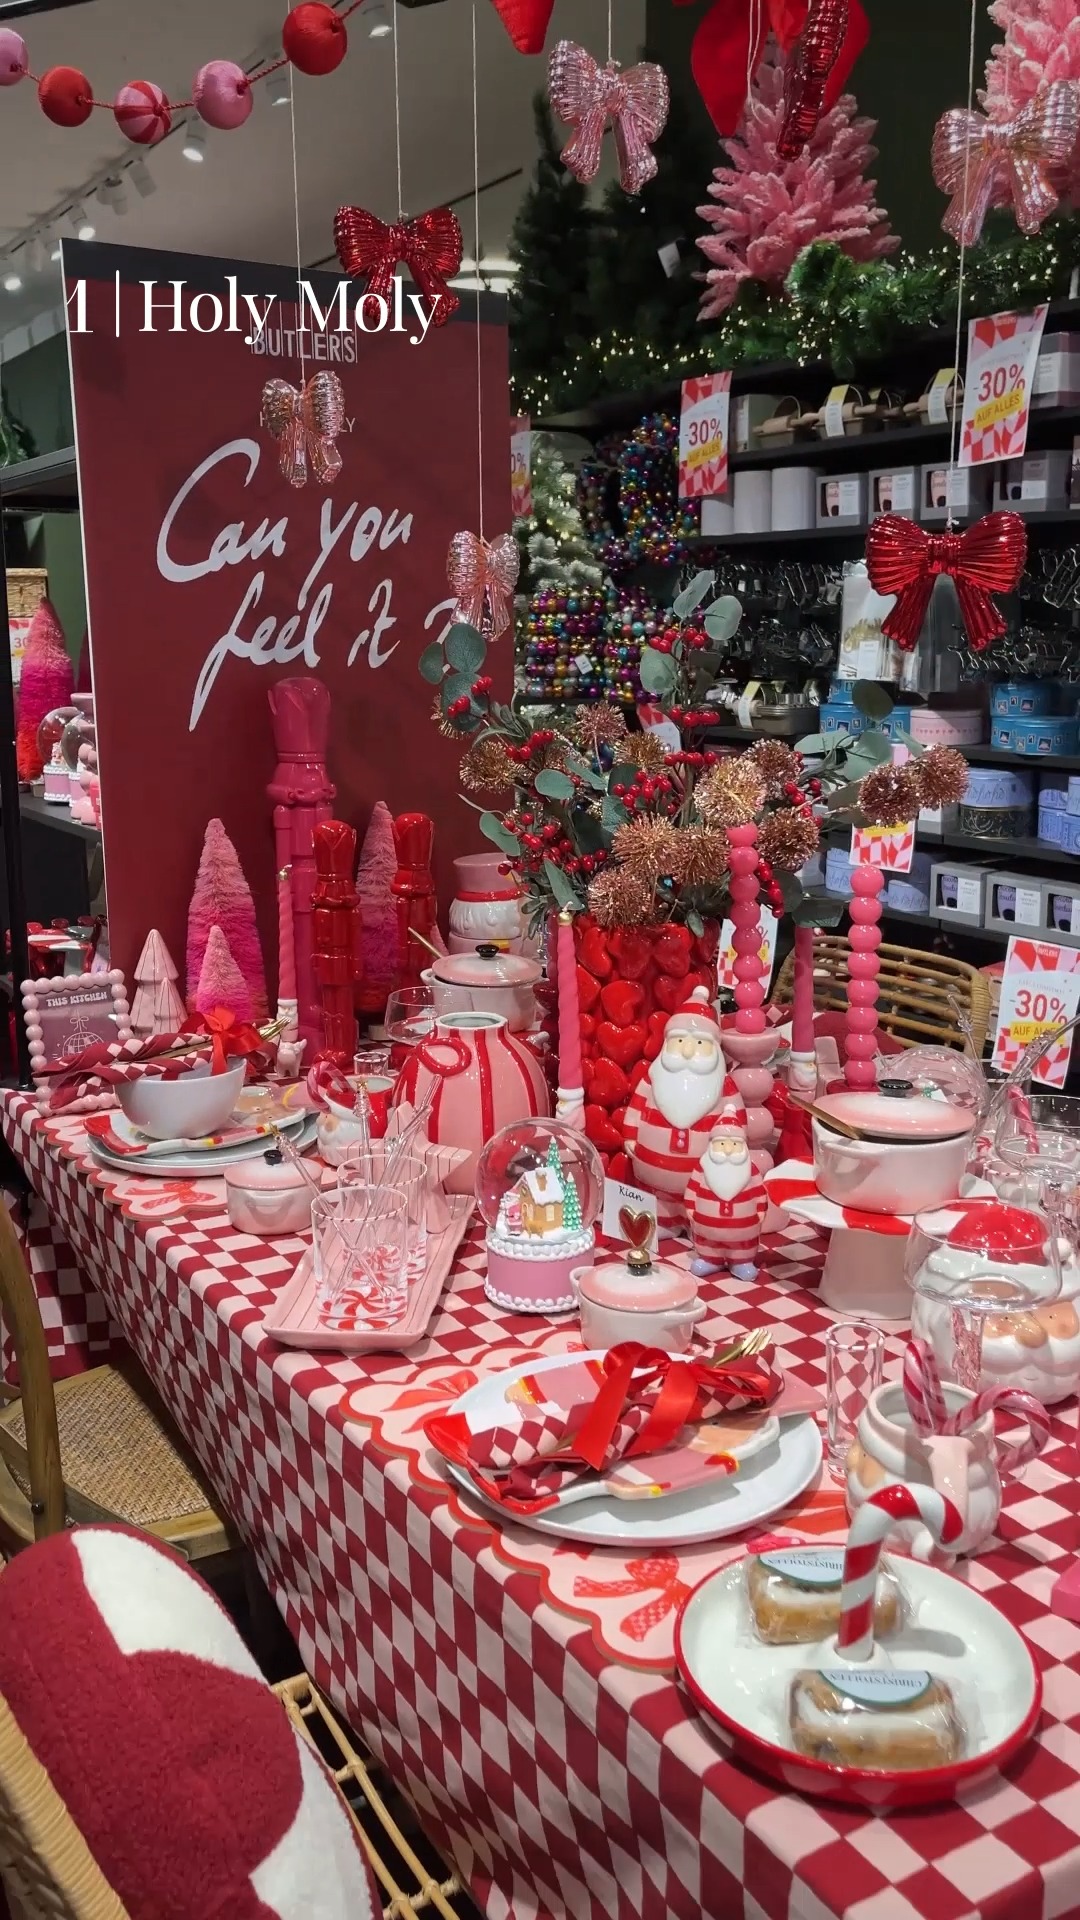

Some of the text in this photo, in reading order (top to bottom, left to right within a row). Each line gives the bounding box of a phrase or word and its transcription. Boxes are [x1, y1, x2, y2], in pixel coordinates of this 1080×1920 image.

[253, 327, 356, 363] BUTLERS
[976, 393, 1020, 424] AUF ALLES
[156, 438, 414, 611] Can you
[188, 571, 334, 733] feel
[347, 578, 401, 669] it
[46, 992, 108, 1007] THIS KITCHEN
[1013, 1026, 1031, 1037] AUF
[618, 1184, 645, 1202] Kian
[767, 1558, 843, 1571] HRISTSTOLLEN
